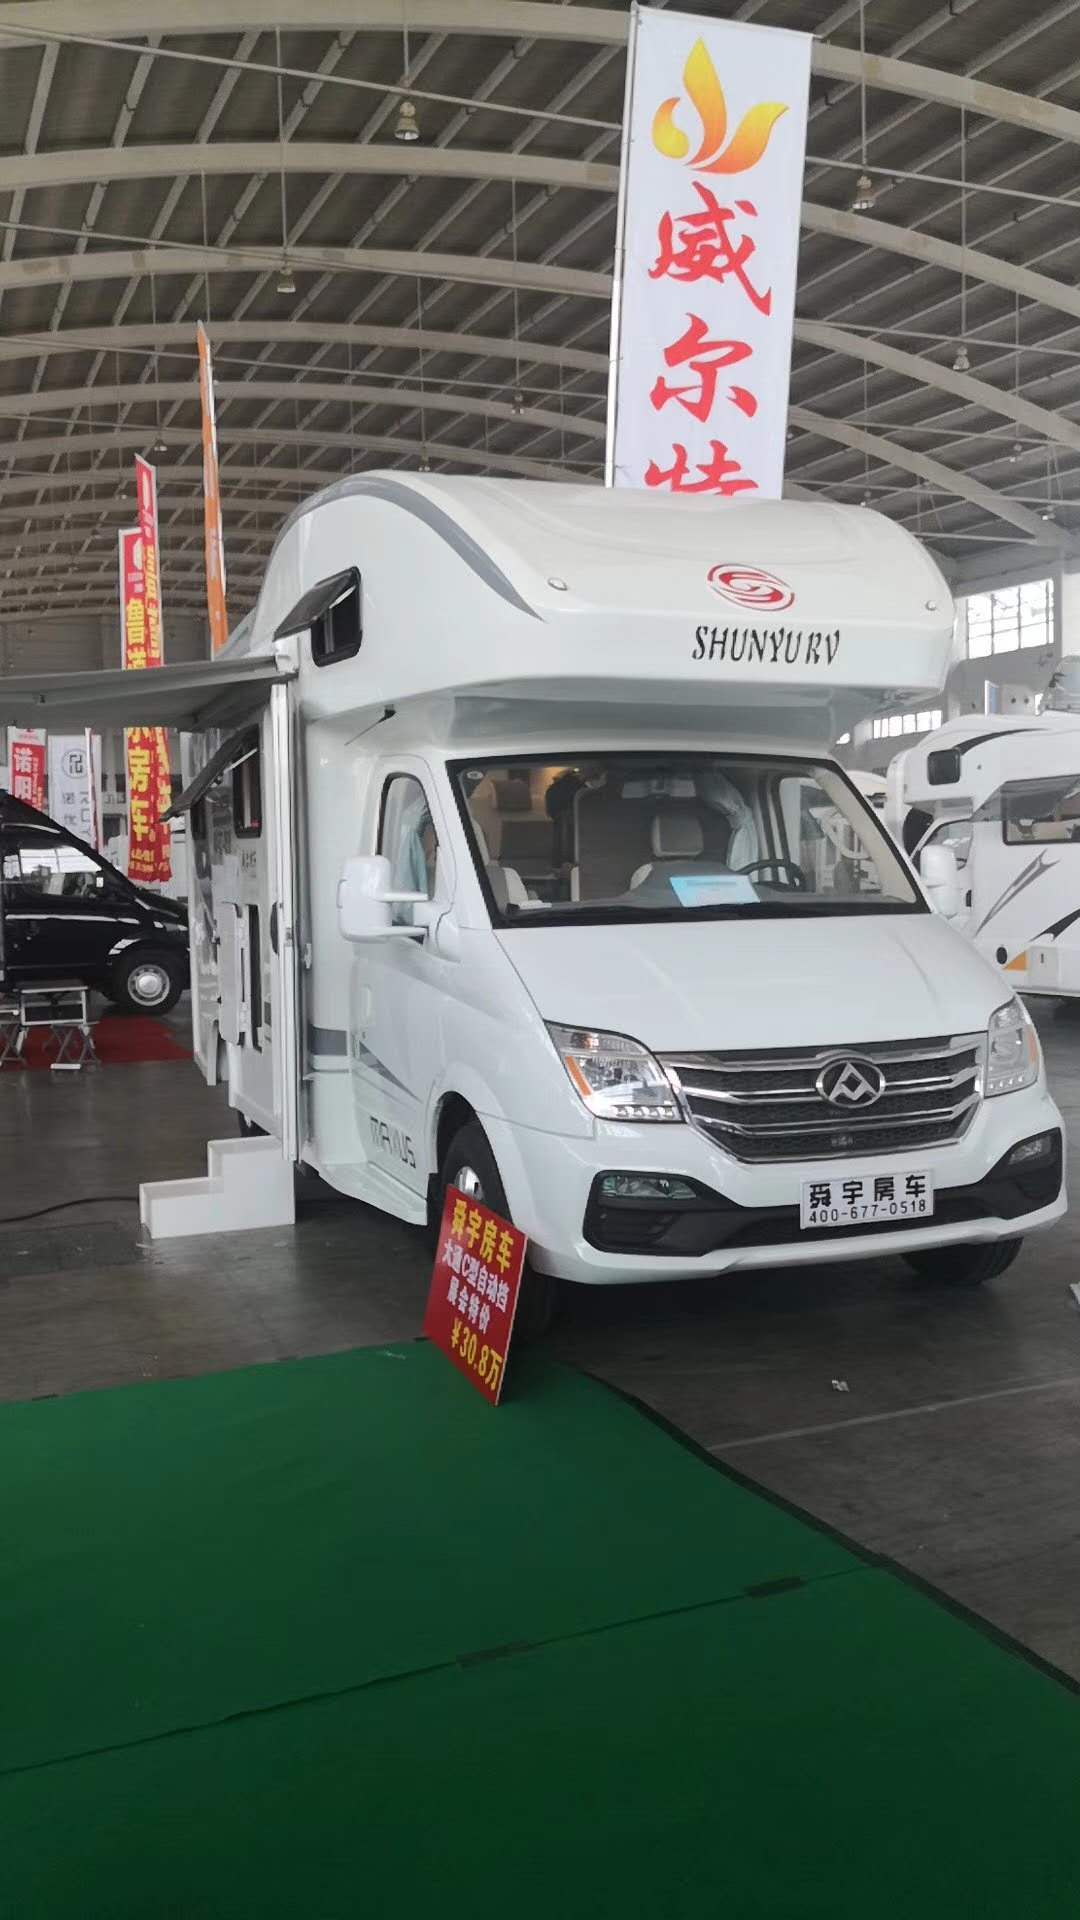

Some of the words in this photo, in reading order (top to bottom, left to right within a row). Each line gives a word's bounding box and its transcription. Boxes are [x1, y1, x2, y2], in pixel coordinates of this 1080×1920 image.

[691, 625, 840, 665] SHUNYURV
[809, 1174, 926, 1209] 舜宇房车
[808, 1199, 927, 1223] 400-677-0518
